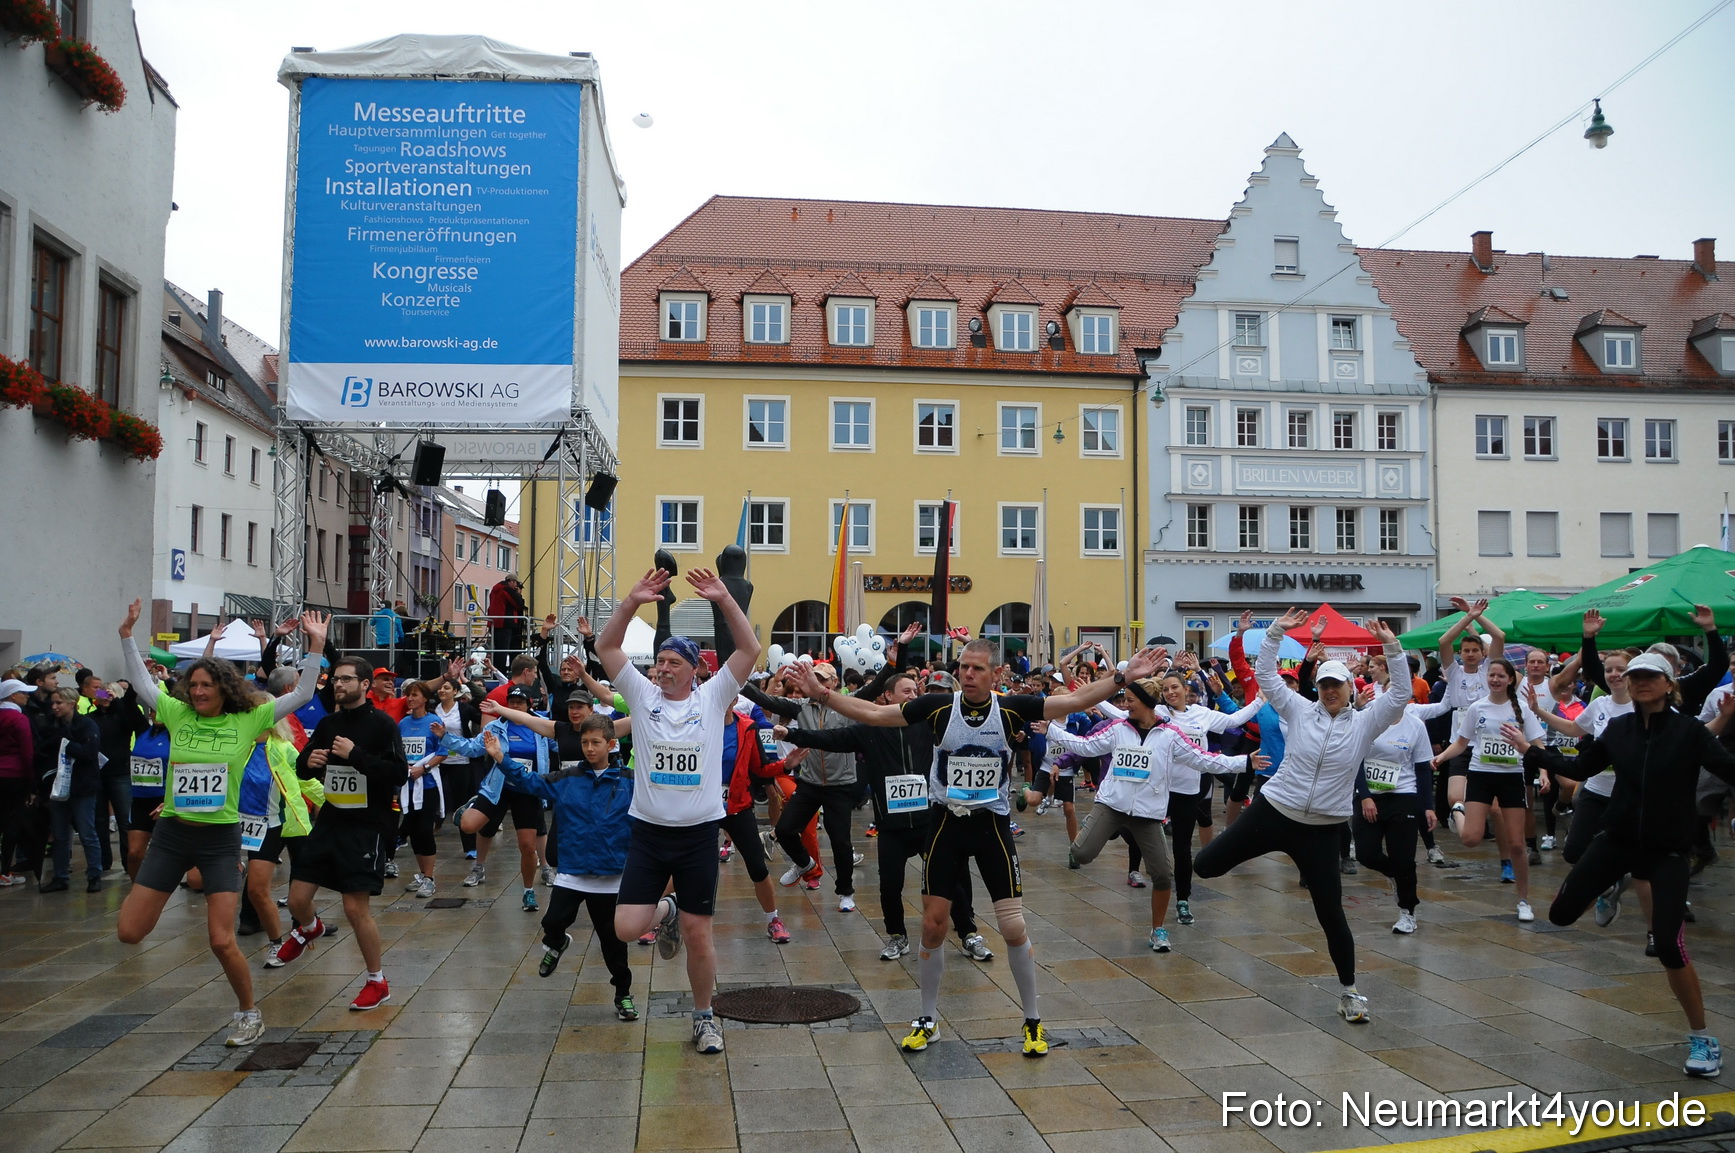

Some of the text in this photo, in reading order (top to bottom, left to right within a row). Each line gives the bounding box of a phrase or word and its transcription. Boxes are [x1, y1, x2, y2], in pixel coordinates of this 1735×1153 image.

[354, 102, 526, 124] Messeauftritte
[328, 124, 547, 142] Hauptversammlungen Get together
[353, 141, 507, 158] Tagungen Roadshows
[345, 159, 531, 179] Sportveranstaltungen
[325, 177, 549, 197] Installationen TV-Produktionen
[340, 200, 482, 214] Kulturveranstaltungen
[364, 215, 530, 226] Fashionshows Produktpräsentationen
[348, 227, 517, 246] Firmeneröffnungen
[369, 244, 438, 254] Firmenjubiläum
[435, 255, 491, 264] Firmenfeiern
[372, 262, 479, 284] Kongresse
[427, 283, 472, 293] Musicals
[381, 292, 461, 307] Konzerte
[401, 308, 450, 316] Tourservice
[364, 337, 499, 351] www.barowski-ag.de
[378, 381, 519, 399] BAROWSKI AG
[378, 400, 439, 408] Veranstaltungs-
[458, 400, 518, 409] Mediensysteme
[1242, 468, 1355, 485] BRILLEN WEBER
[1228, 572, 1365, 591] BRILLEN WEBER
[1484, 742, 1515, 756] 5038
[133, 763, 160, 775] 5173
[655, 753, 697, 772] 3180
[1116, 753, 1149, 769] 3029
[953, 769, 995, 787] 2132
[1366, 766, 1394, 782] 5041
[178, 775, 222, 794] 2412
[331, 776, 357, 792] 576
[890, 783, 923, 798] 2677
[185, 798, 213, 806] Daniela
